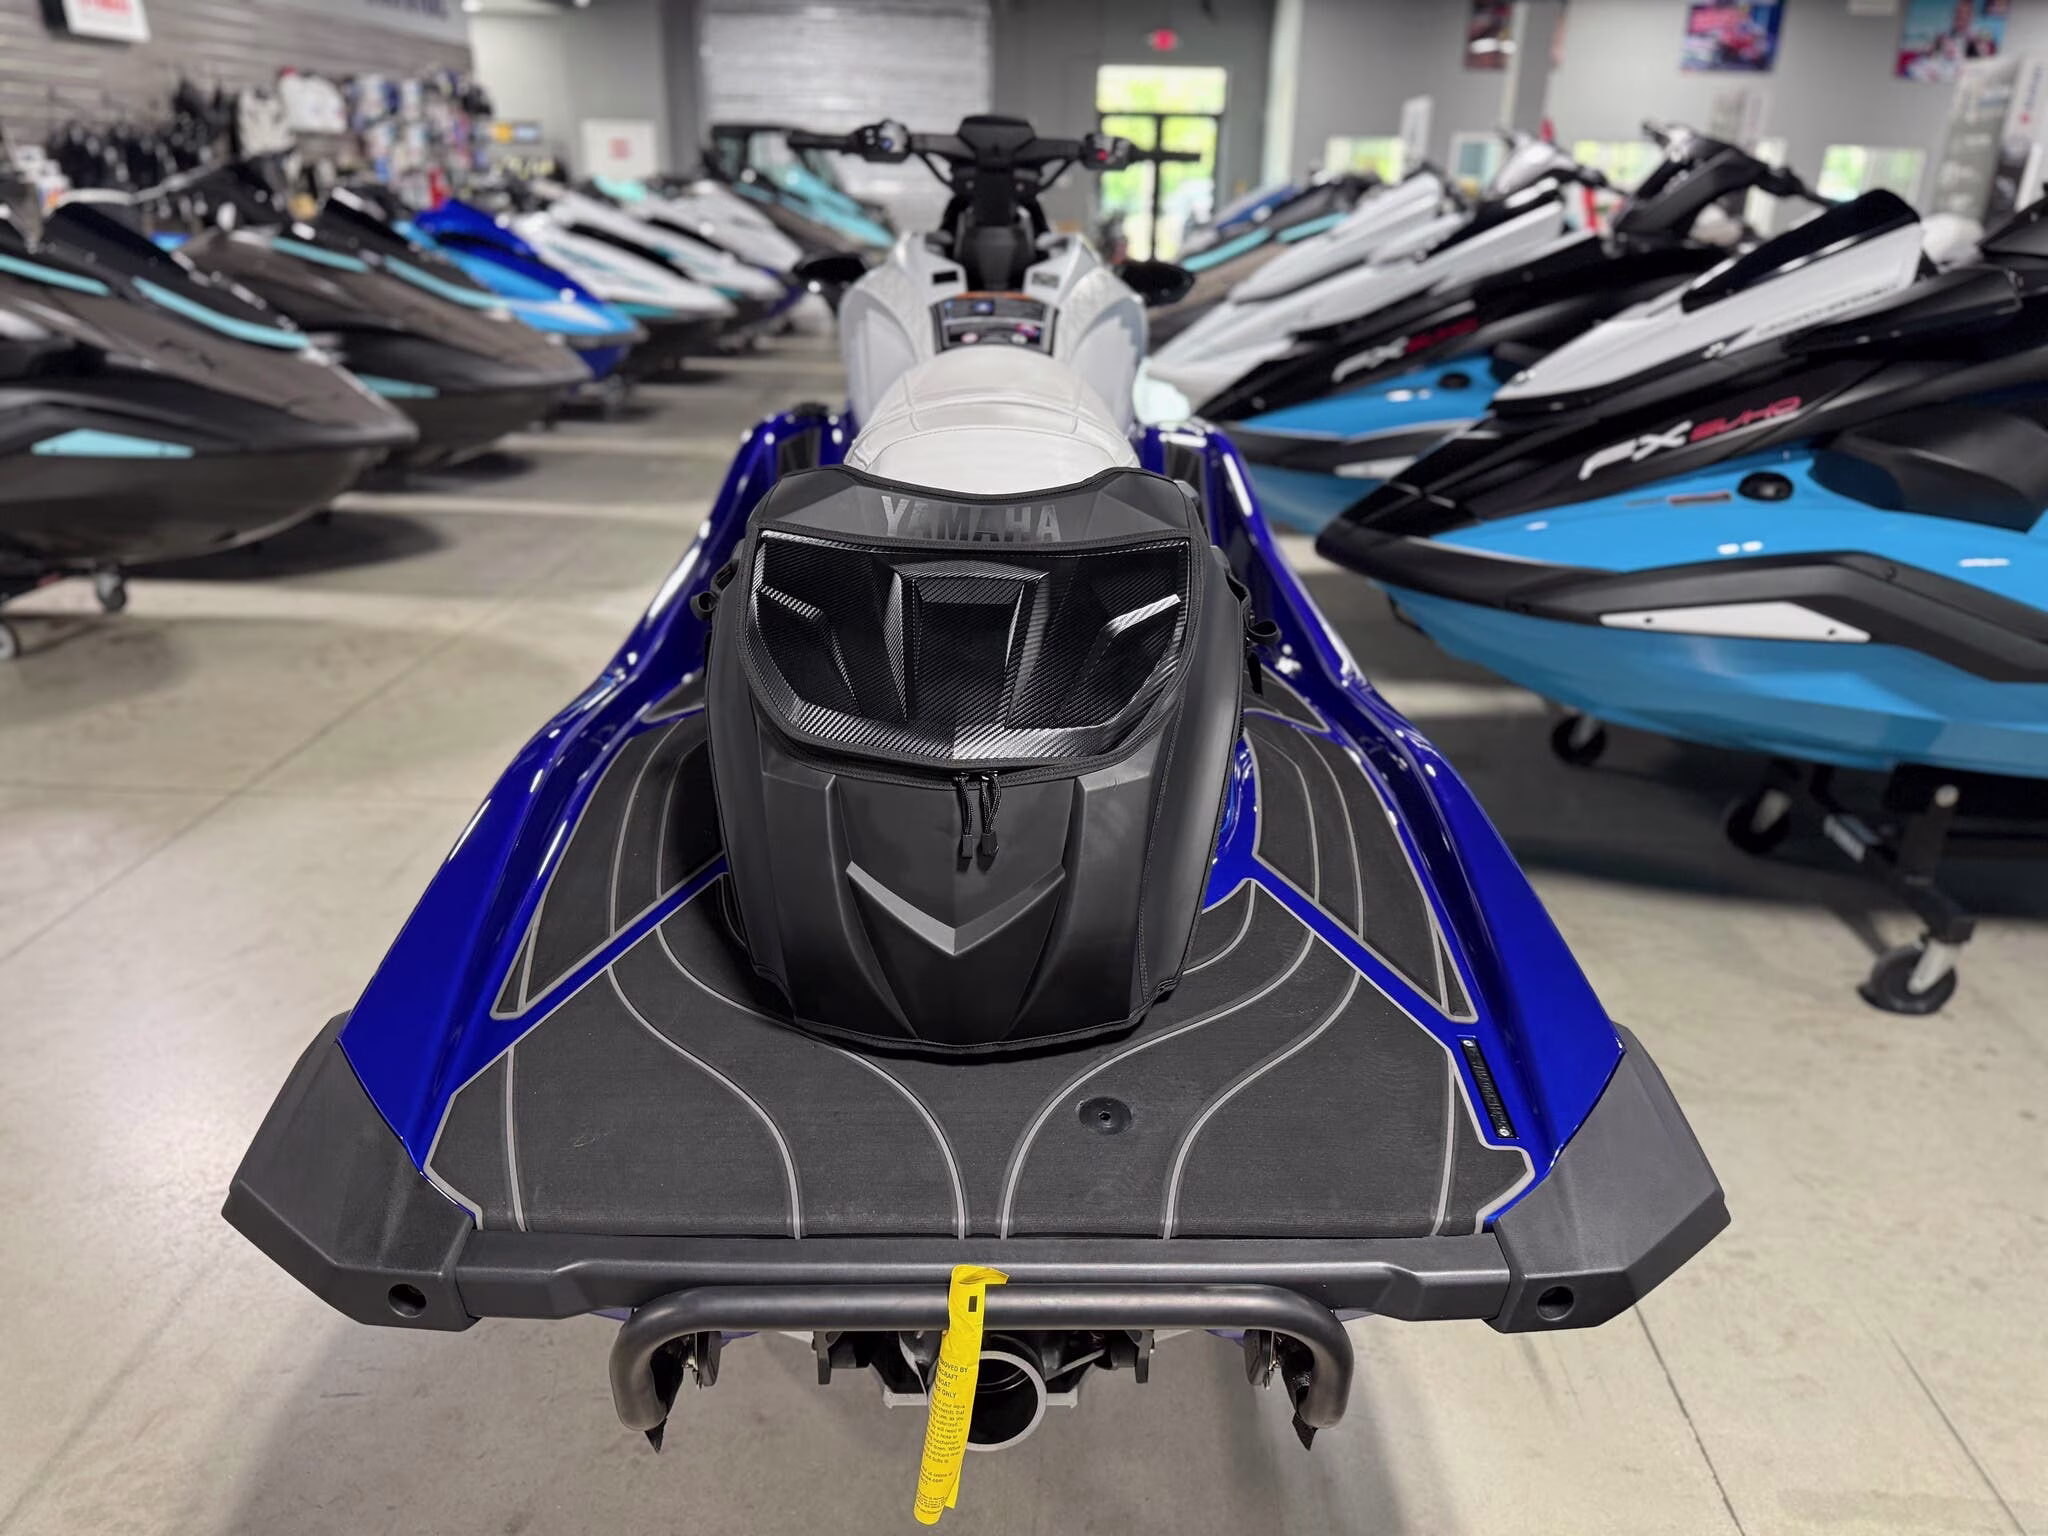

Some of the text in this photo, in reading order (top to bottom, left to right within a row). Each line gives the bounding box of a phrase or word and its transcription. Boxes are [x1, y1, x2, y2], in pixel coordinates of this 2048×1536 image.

[1578, 420, 1692, 480] FX
[881, 495, 1061, 543] YAMAHA
[941, 1389, 957, 1399] ONLY
